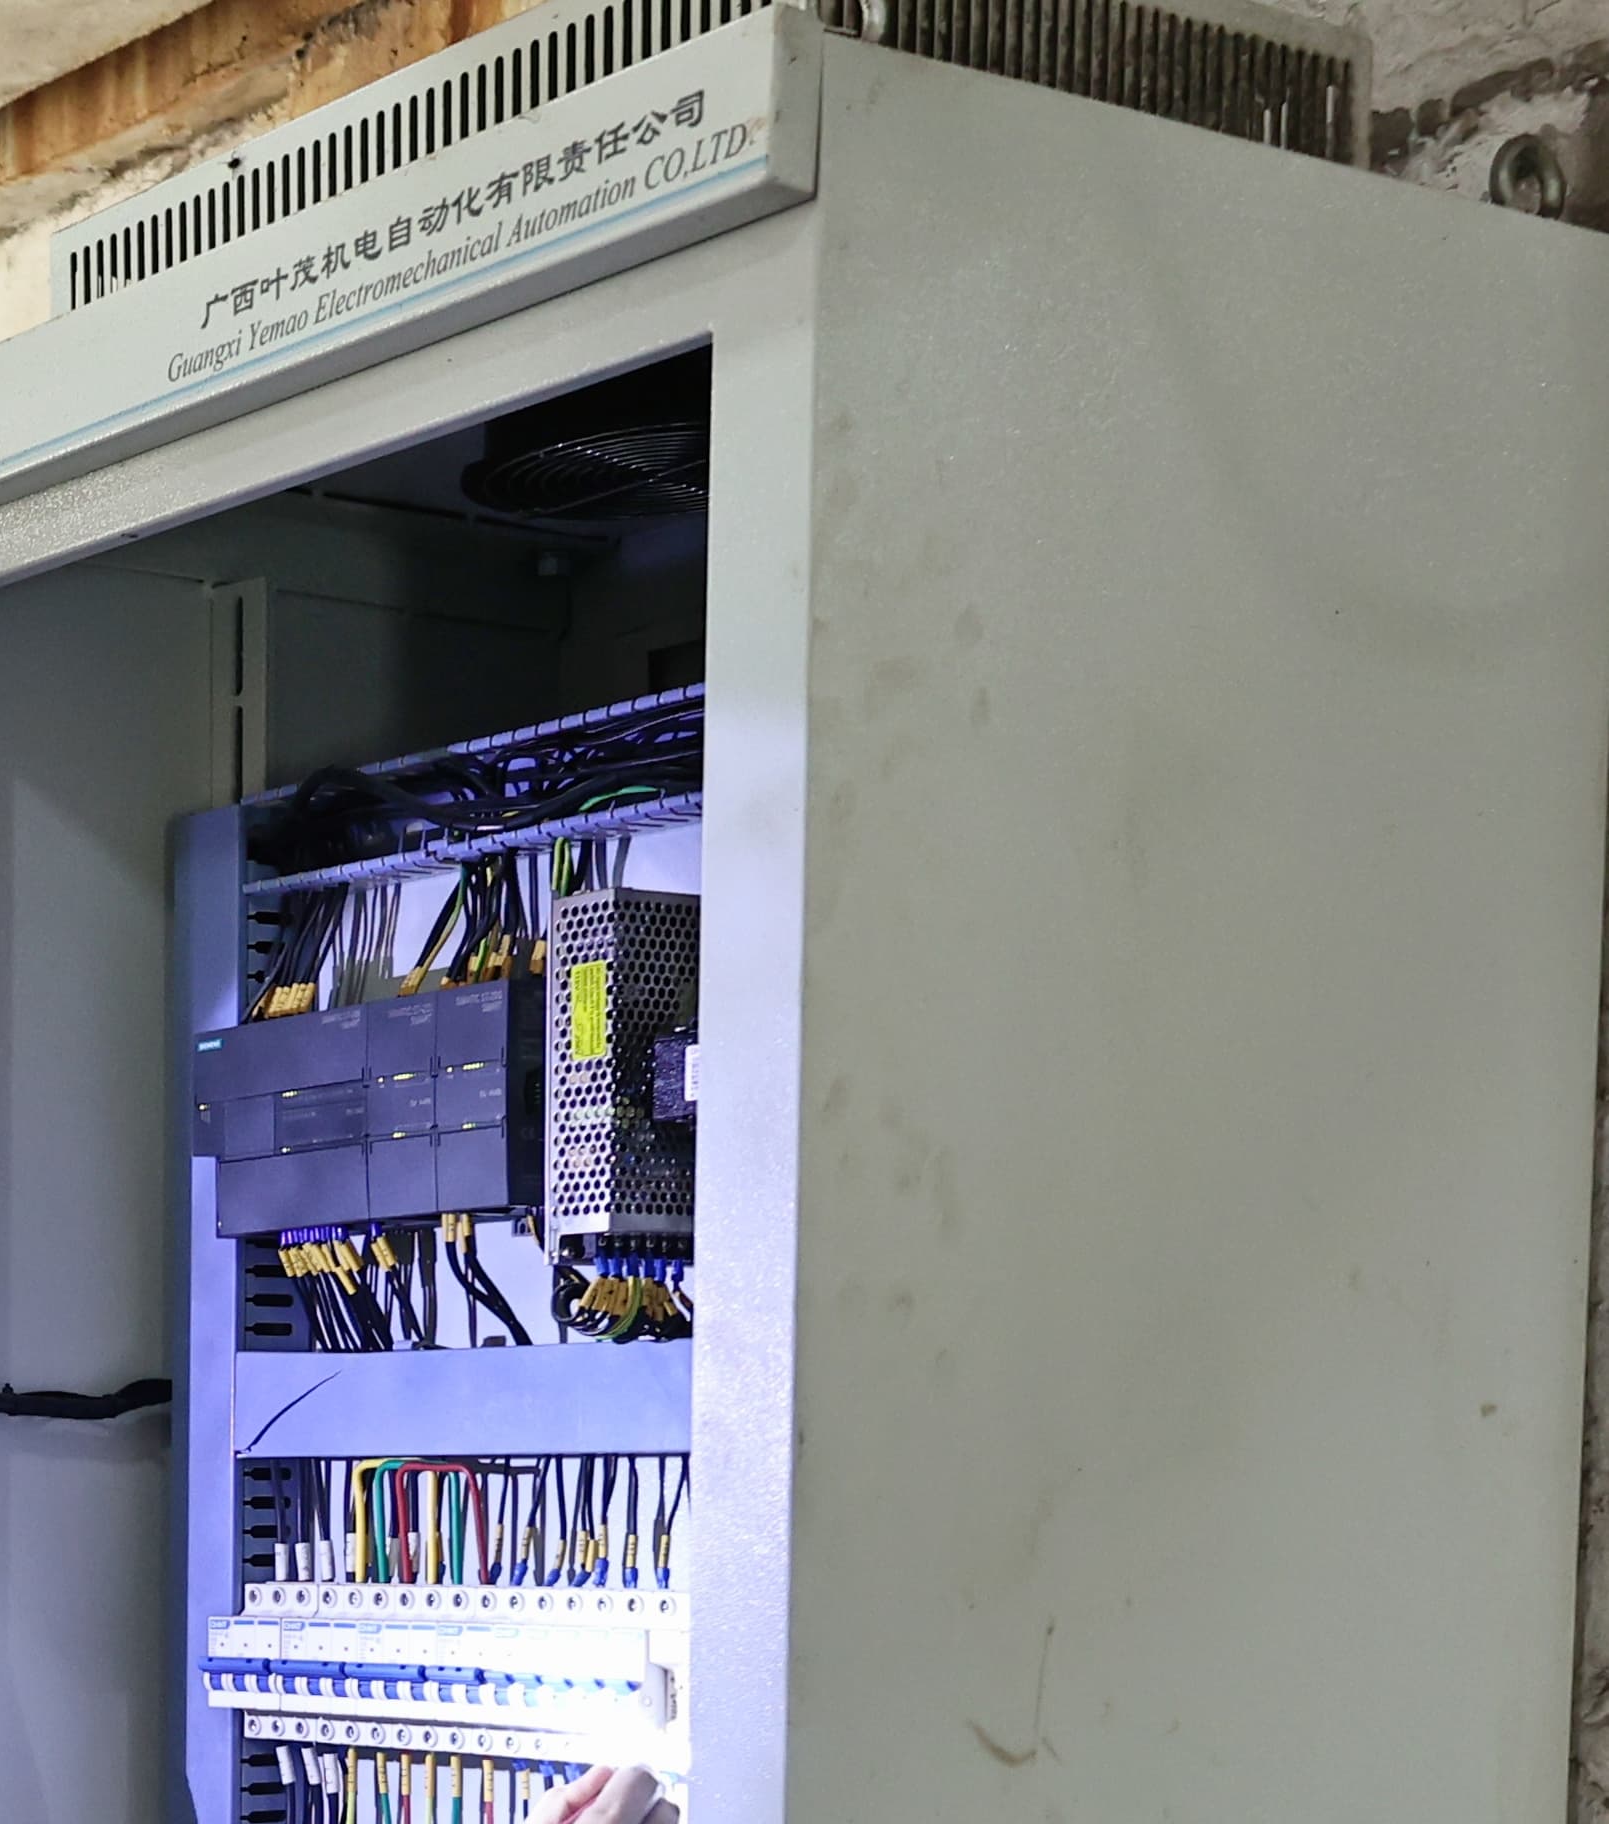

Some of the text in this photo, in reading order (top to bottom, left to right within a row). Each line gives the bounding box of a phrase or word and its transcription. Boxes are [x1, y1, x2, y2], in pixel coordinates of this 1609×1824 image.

[168, 330, 242, 382] Guangxi
[249, 310, 308, 351] Yemao
[314, 222, 503, 325] Electromechanical
[506, 176, 636, 248] Automation
[200, 89, 705, 329] 广西叶茂机电自动化有限责任公司
